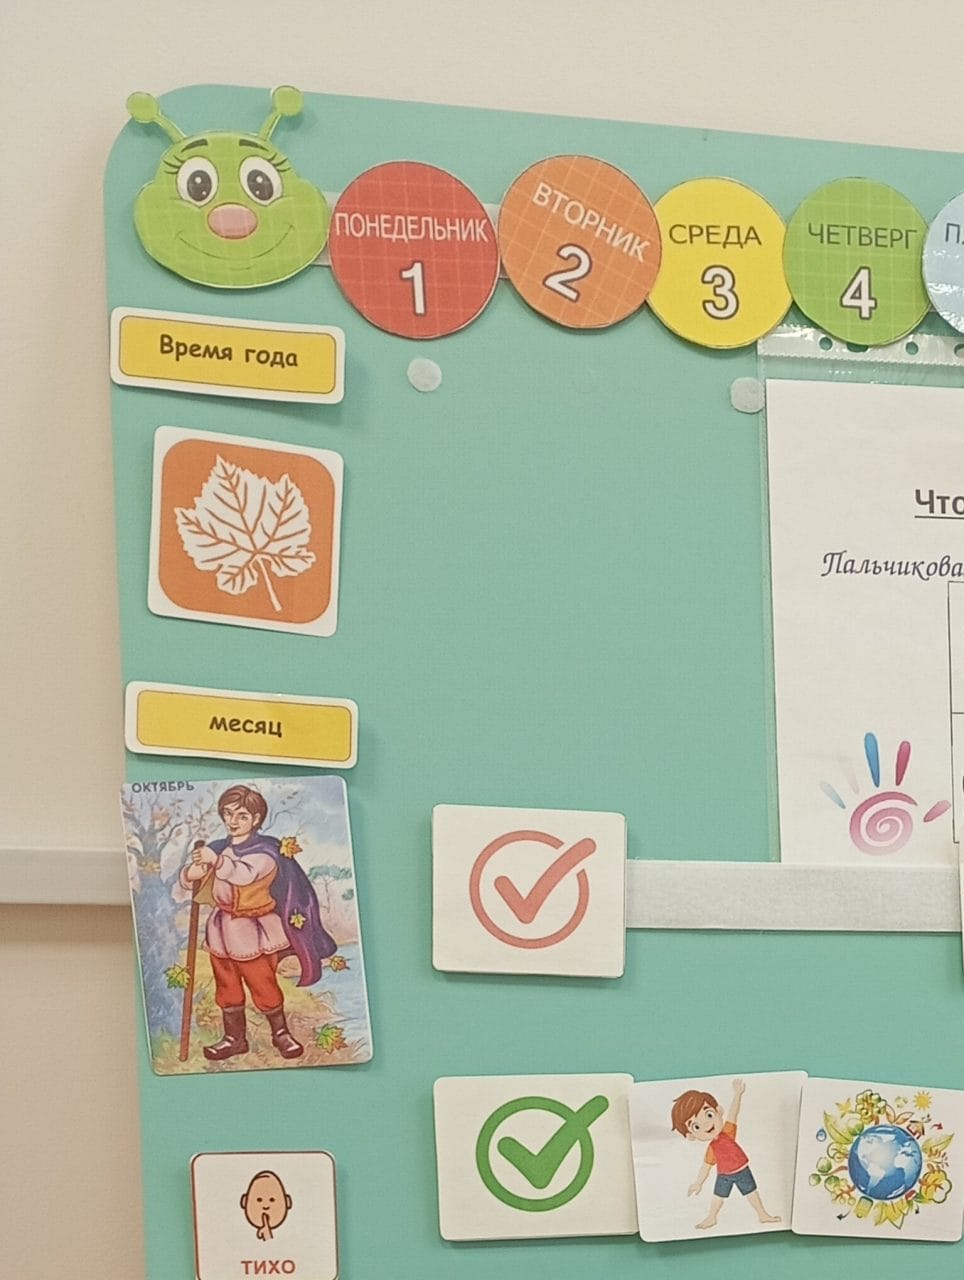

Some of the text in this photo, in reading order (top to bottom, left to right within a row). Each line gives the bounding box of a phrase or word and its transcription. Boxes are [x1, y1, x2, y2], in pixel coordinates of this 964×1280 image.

[335, 211, 490, 243] ПОНЕДЕЛЬНИК
[530, 181, 651, 265] ВТОРНИК
[668, 222, 763, 250] СРЕДА
[807, 222, 918, 250] ЧЕТВЕРГ
[400, 260, 427, 317] 1
[542, 243, 594, 304] 2
[700, 264, 740, 320] 3
[839, 266, 877, 320] 4
[158, 333, 299, 369] Время года
[209, 715, 283, 738] месяц
[131, 780, 195, 794] ОКТЯБРЬ
[240, 1259, 297, 1275] ТИХО
